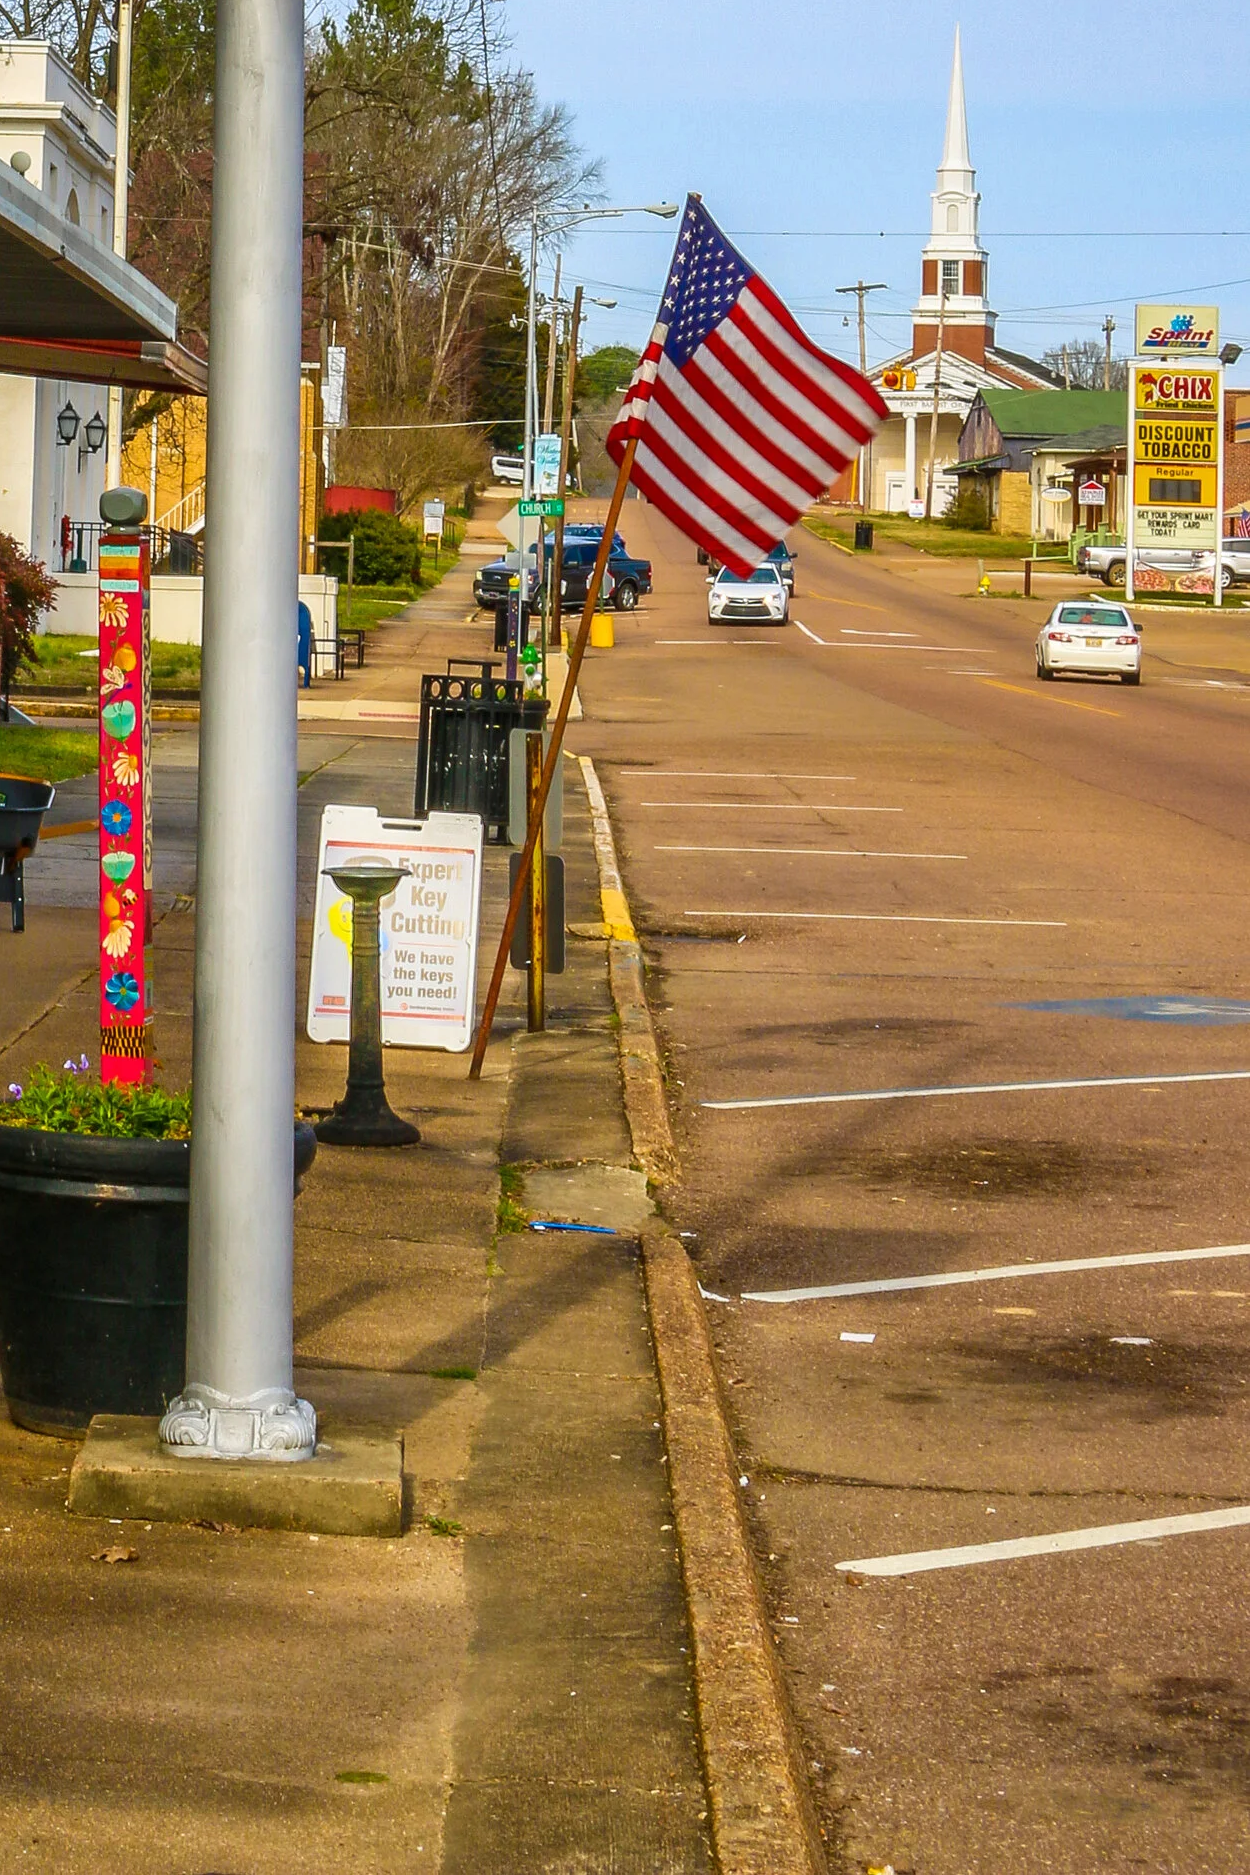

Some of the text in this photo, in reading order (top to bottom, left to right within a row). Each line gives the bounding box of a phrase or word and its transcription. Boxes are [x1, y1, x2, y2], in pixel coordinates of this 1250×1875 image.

[1148, 327, 1214, 345] Sprint
[1158, 376, 1212, 400] CHIX
[1138, 425, 1215, 442] DISCOUNT
[1142, 442, 1211, 459] TOBACCO
[1156, 468, 1194, 477] Regular
[521, 503, 551, 515] CHURCH
[1137, 511, 1213, 522] GET YOUR SPRINT MART
[1148, 520, 1200, 529] REWARDS CARD
[1151, 529, 1176, 537] TODAY!
[398, 858, 463, 882] Expert
[411, 886, 447, 912] Key
[391, 913, 465, 941] Cutting
[395, 950, 454, 965] We have
[393, 967, 453, 983] the keys
[387, 985, 457, 1000] you need!
